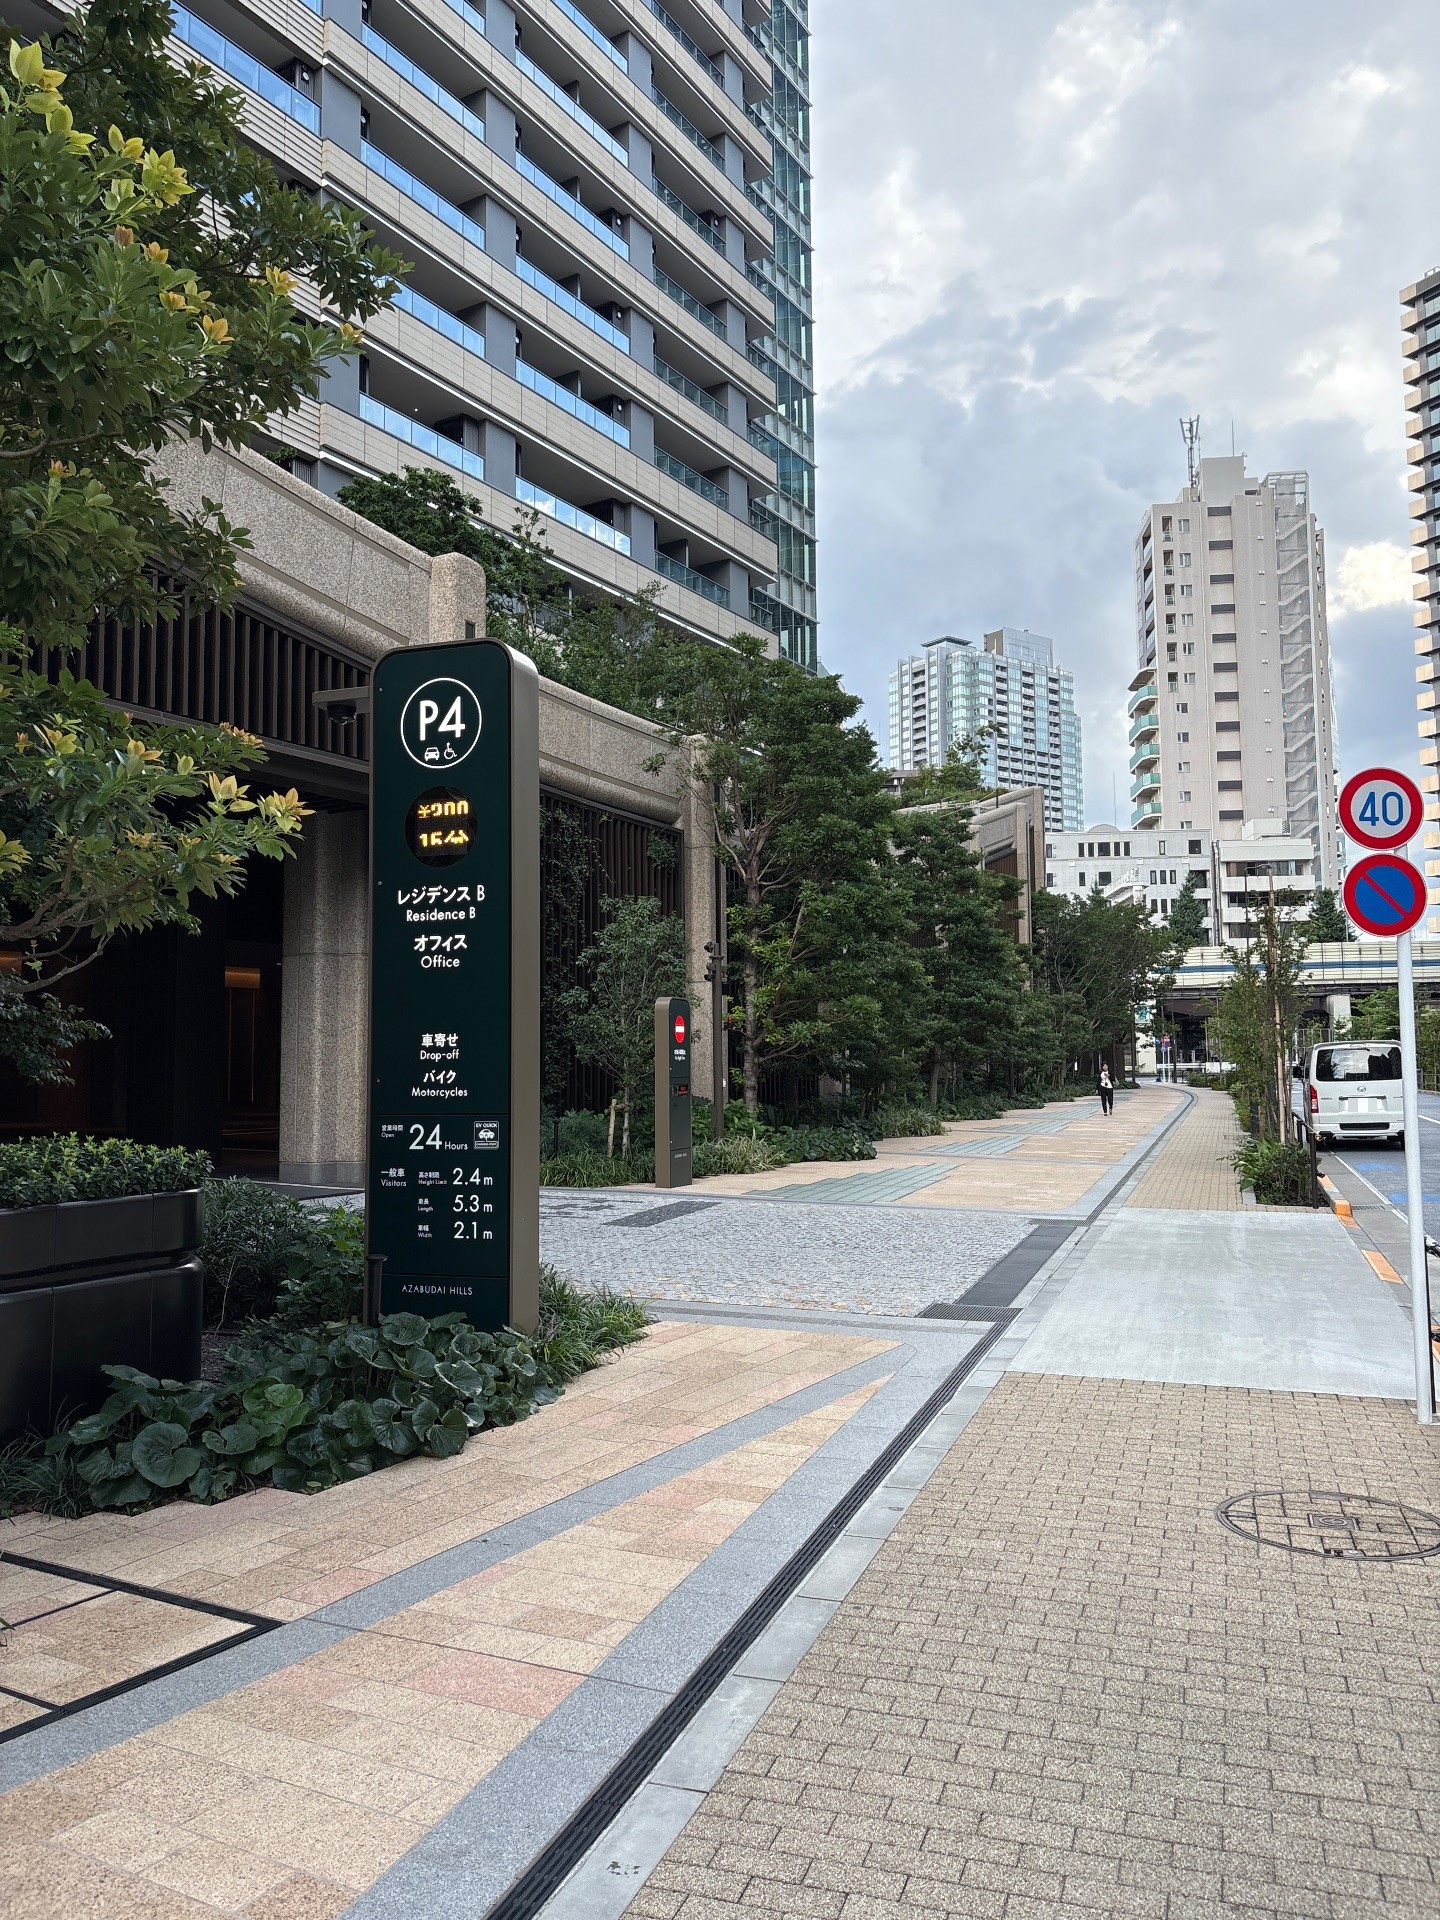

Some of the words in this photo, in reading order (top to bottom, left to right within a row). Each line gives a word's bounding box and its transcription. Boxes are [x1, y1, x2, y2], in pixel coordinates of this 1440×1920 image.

[419, 695, 466, 741] P4
[1358, 791, 1404, 826] 40
[397, 885, 471, 905] レジデンス
[477, 884, 485, 901] B
[406, 908, 466, 921] Residence
[469, 906, 476, 918] B
[413, 934, 468, 952] オフィス
[420, 954, 461, 968] Office
[421, 1032, 459, 1047] 車寄せ
[420, 1049, 459, 1062] Drop-off
[423, 1069, 457, 1084] バイク
[411, 1087, 468, 1099] Motorcycles
[409, 1123, 443, 1150] 24
[444, 1141, 468, 1150] Hours
[380, 1178, 407, 1187] Visitors
[452, 1167, 481, 1186] 2.4
[483, 1176, 493, 1186] m
[452, 1194, 480, 1213] 5.3
[483, 1203, 493, 1213] m
[453, 1221, 477, 1239] 2.1
[482, 1230, 493, 1240] m
[401, 1284, 446, 1295] AZABUDAI
[449, 1286, 473, 1296] HILLS
